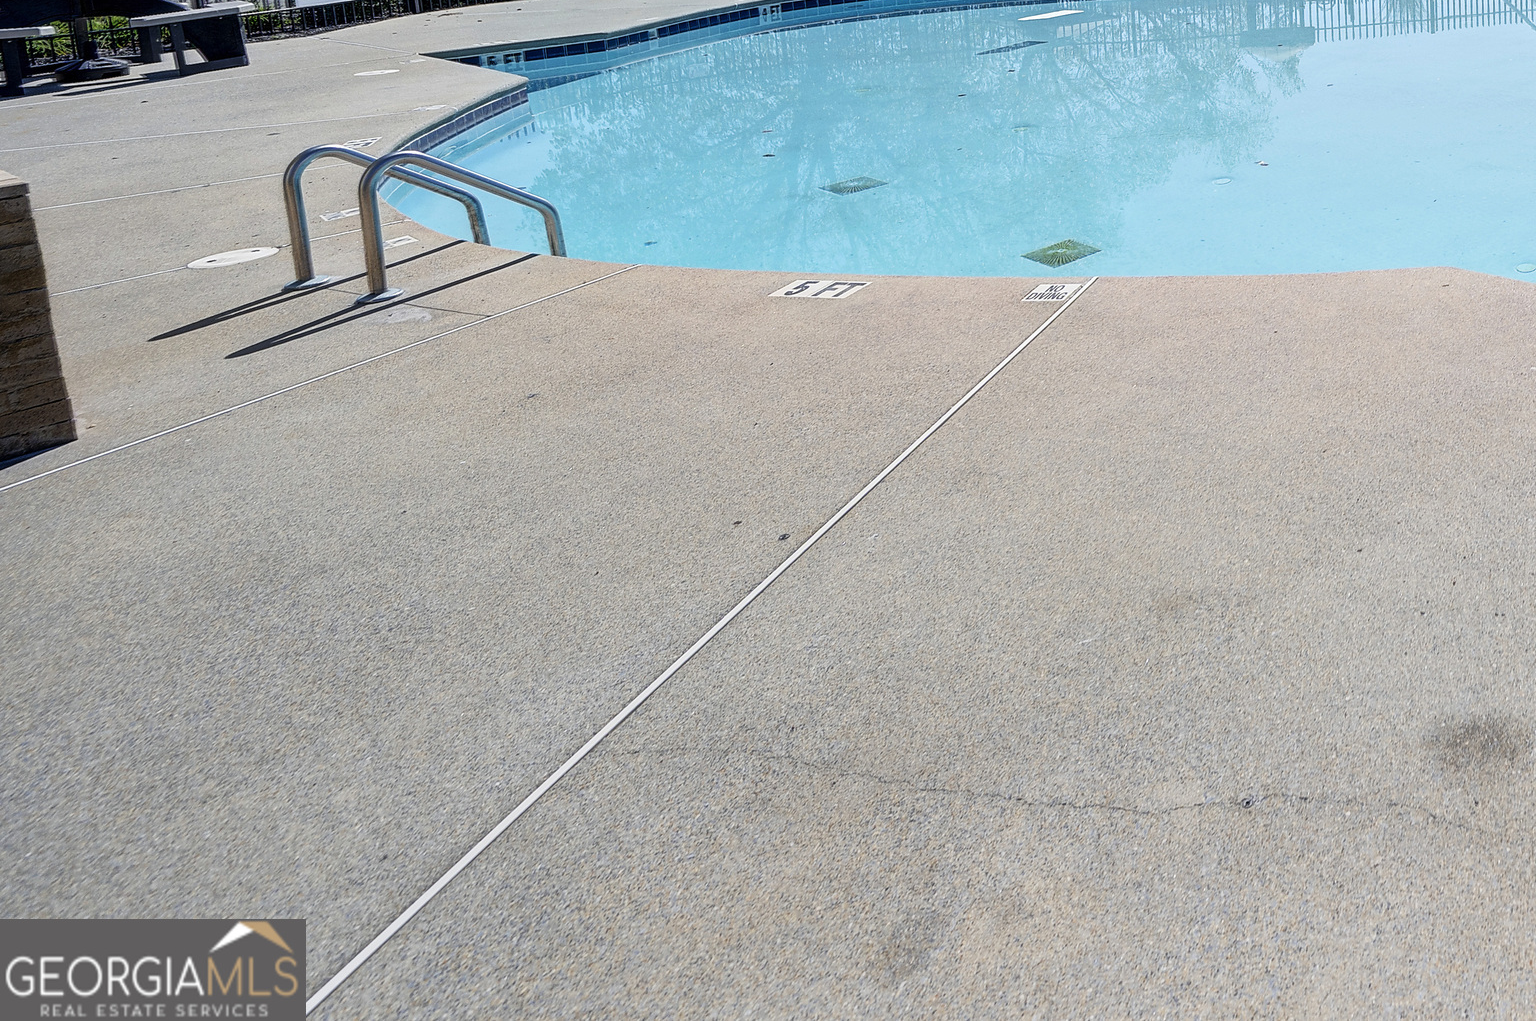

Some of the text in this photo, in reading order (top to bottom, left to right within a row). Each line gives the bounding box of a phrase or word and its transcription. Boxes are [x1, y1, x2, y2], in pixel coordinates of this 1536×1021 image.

[784, 280, 867, 298] 5 FT
[1044, 284, 1066, 293] NO
[1025, 292, 1068, 300] DIVING
